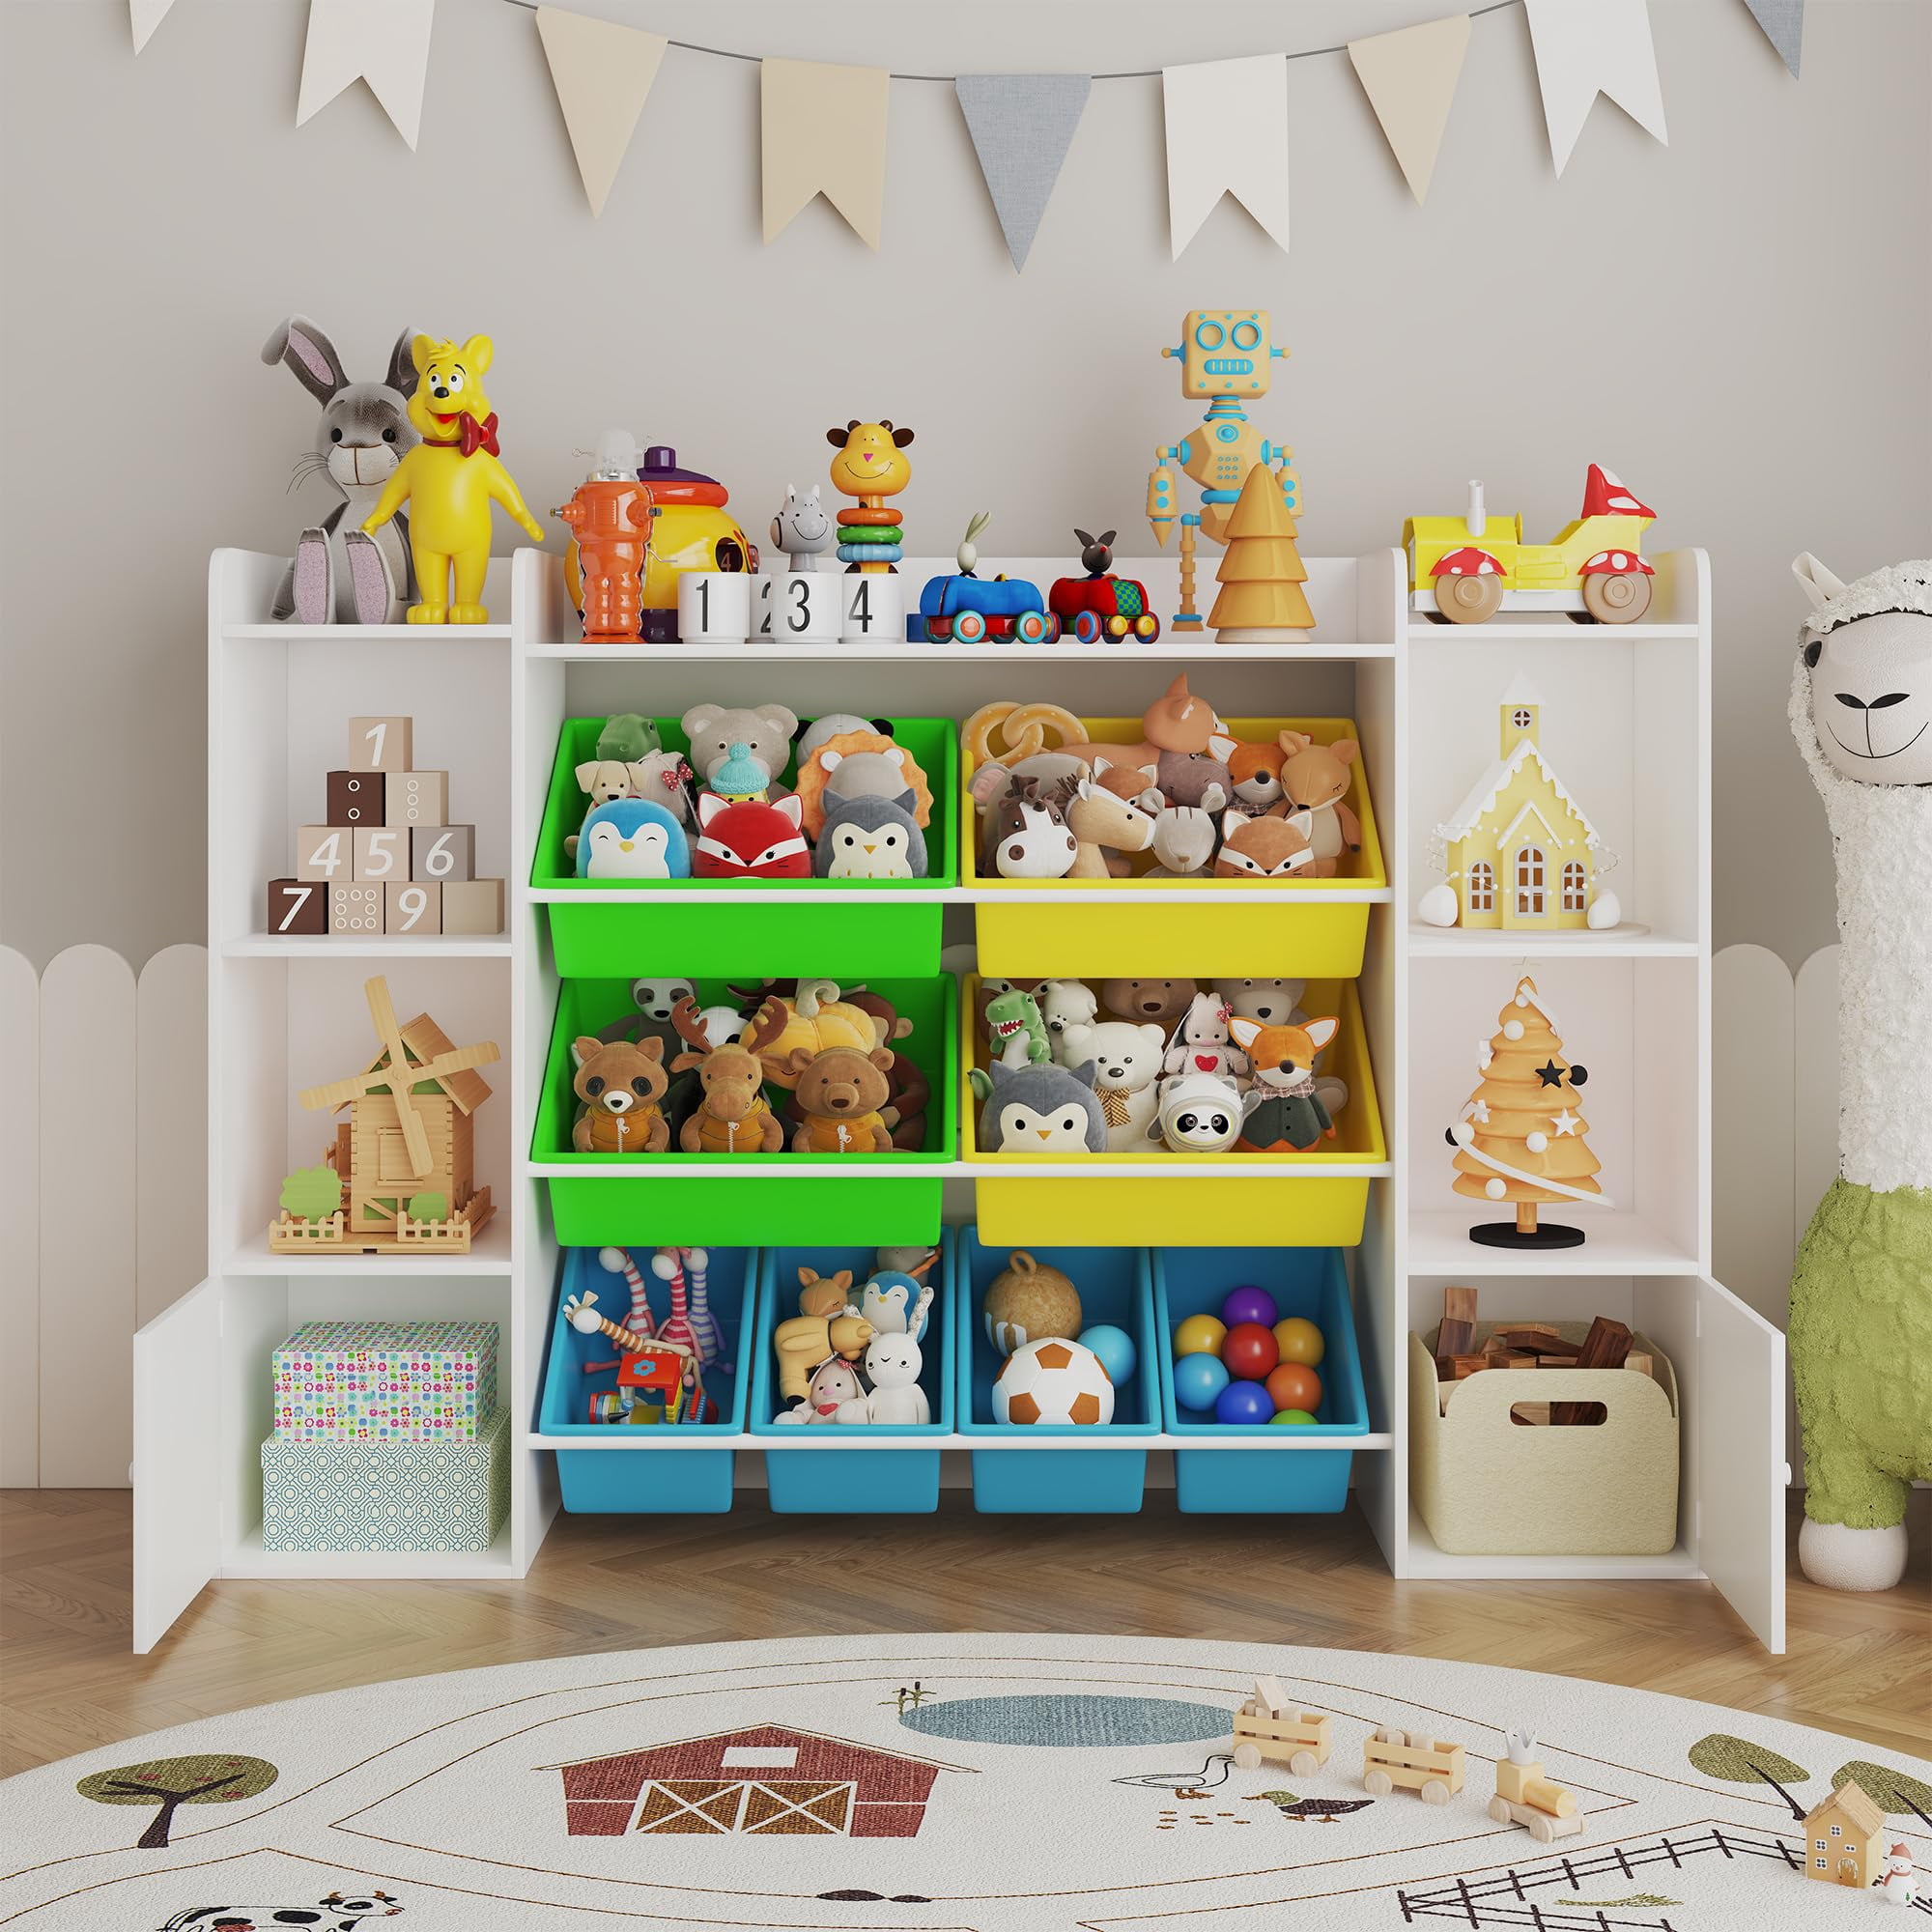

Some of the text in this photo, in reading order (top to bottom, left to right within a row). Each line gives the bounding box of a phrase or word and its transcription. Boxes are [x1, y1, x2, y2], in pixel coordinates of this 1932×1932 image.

[696, 580, 709, 633] 1
[787, 580, 810, 633] 3
[848, 580, 873, 634] 4
[365, 723, 387, 767] 1
[308, 833, 342, 877] 4
[364, 833, 397, 877] 5
[425, 833, 454, 877] 6
[278, 887, 313, 931] 7
[398, 887, 427, 931] 9
